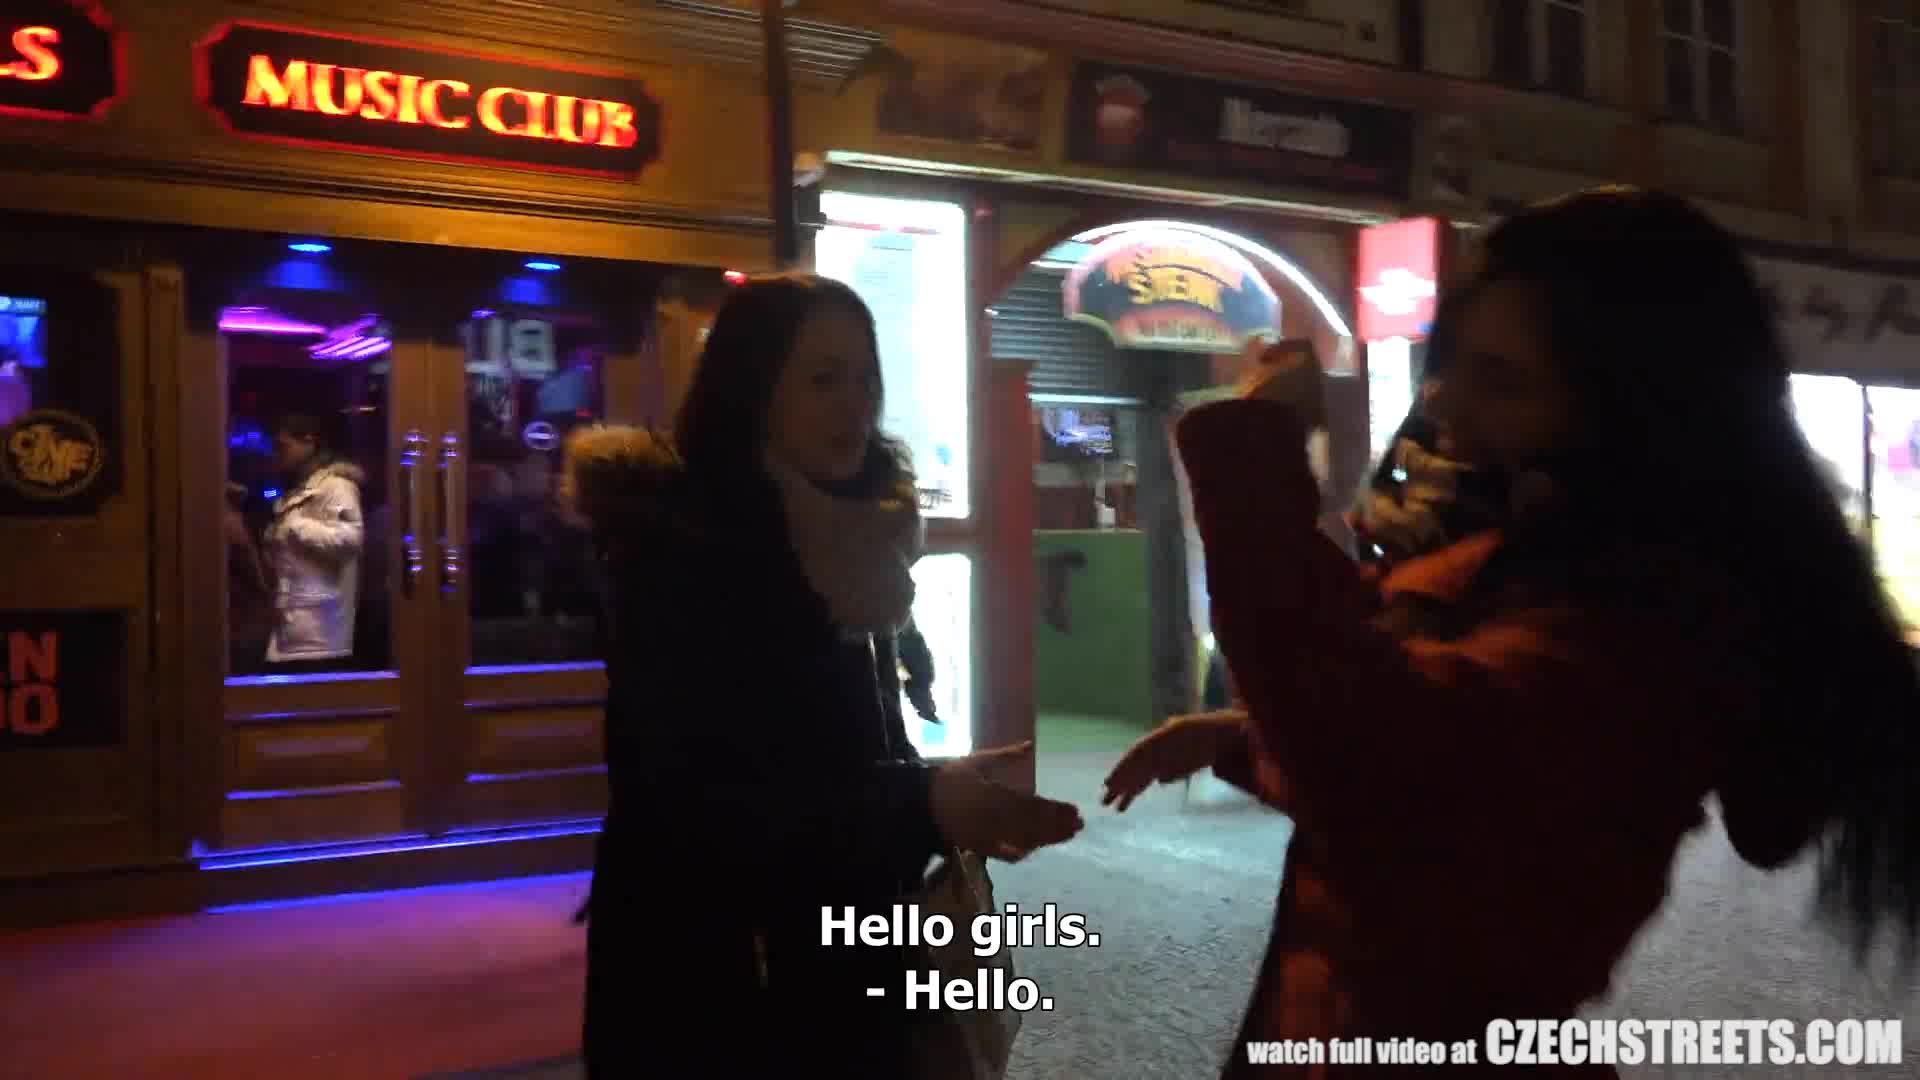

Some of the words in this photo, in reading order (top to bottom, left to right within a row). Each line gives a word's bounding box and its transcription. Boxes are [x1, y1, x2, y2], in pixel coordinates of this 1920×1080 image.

[0, 26, 60, 80] S
[241, 54, 471, 130] MUSIC
[477, 86, 639, 149] CLUB
[0, 630, 58, 682] N
